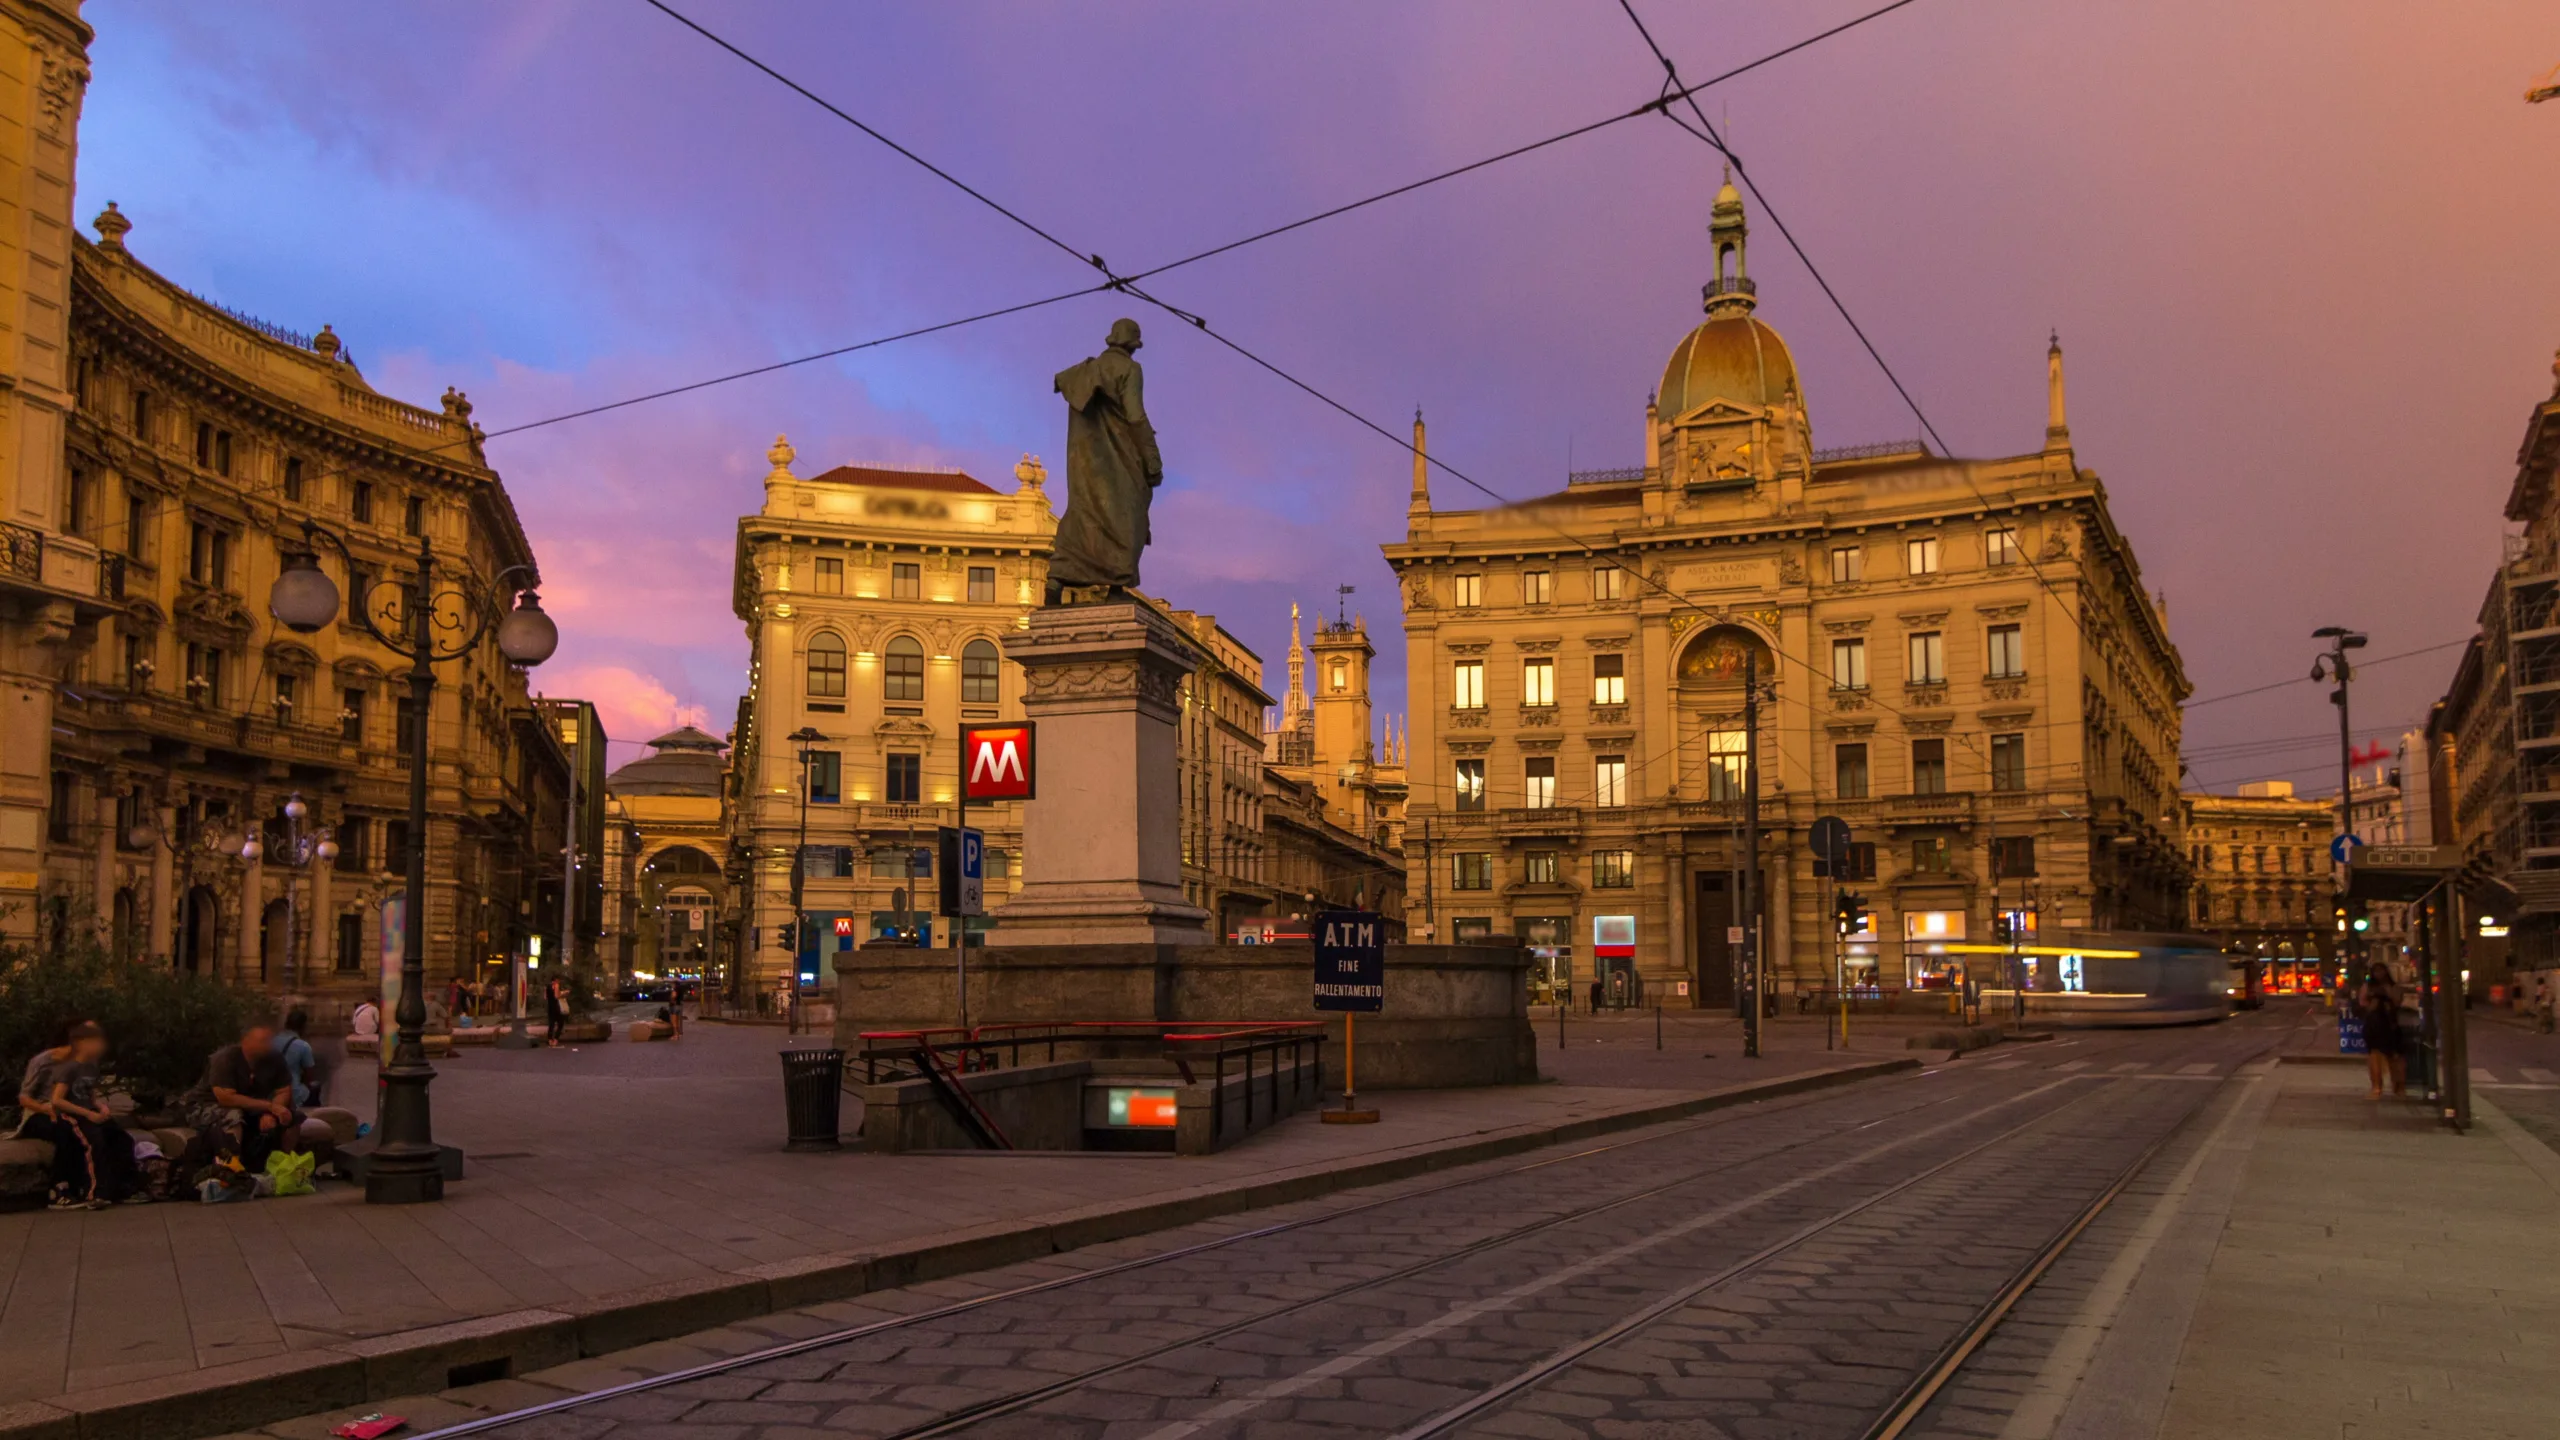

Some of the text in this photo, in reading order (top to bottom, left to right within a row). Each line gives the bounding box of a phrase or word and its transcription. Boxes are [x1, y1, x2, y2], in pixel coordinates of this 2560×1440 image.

[970, 741, 1024, 783] M
[967, 839, 977, 872] P
[836, 921, 851, 933] M
[1323, 922, 1377, 948] A.T.M.
[1338, 959, 1359, 973] FINE
[1314, 983, 1382, 997] RALLENTAMENTO
